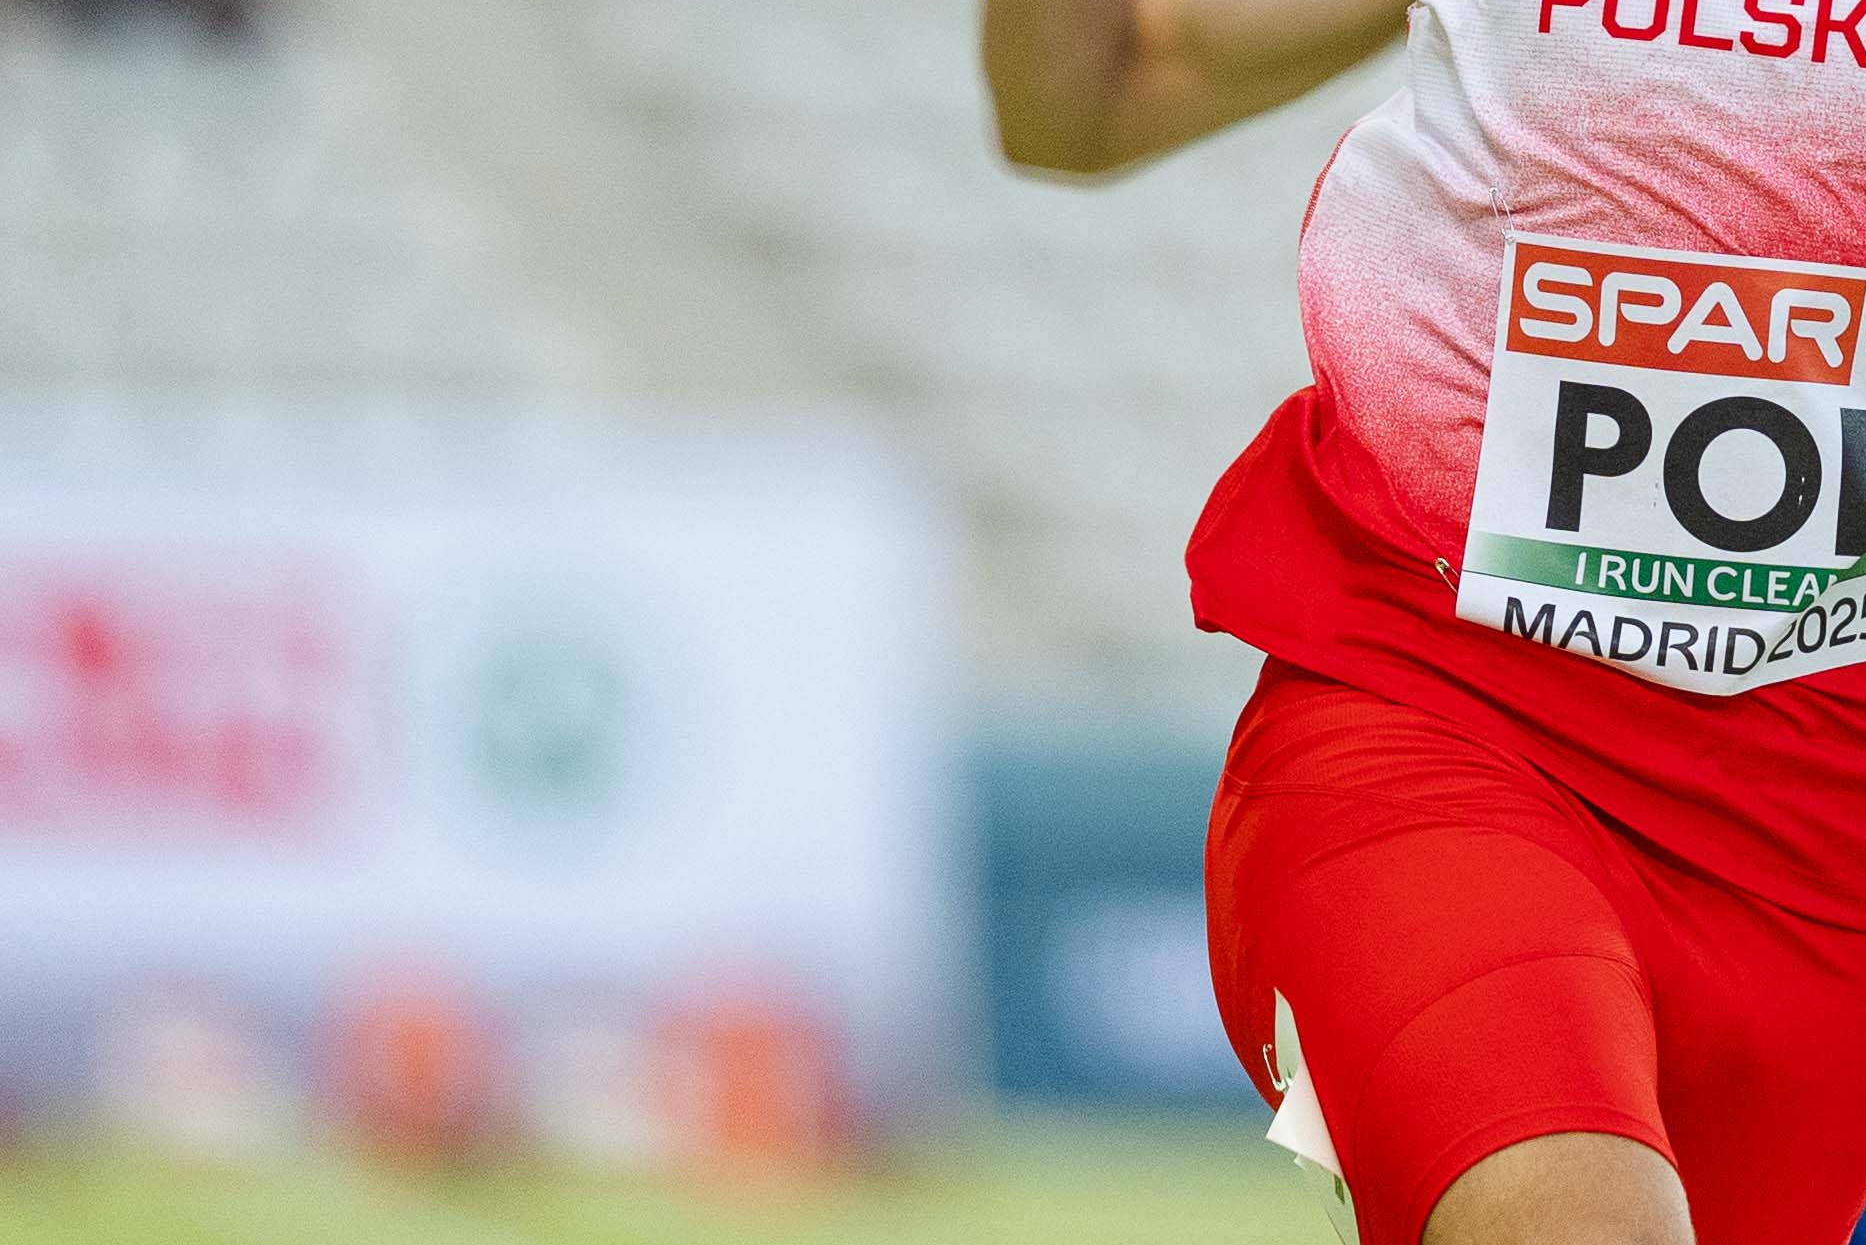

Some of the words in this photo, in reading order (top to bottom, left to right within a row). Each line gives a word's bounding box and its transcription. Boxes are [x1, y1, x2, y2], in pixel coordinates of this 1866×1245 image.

[1519, 261, 1852, 368] SPAR
[1575, 552, 1588, 585] I
[1599, 554, 1695, 597] RUN
[1706, 566, 1838, 606] CLEA
[1503, 596, 1766, 676] MADRID
